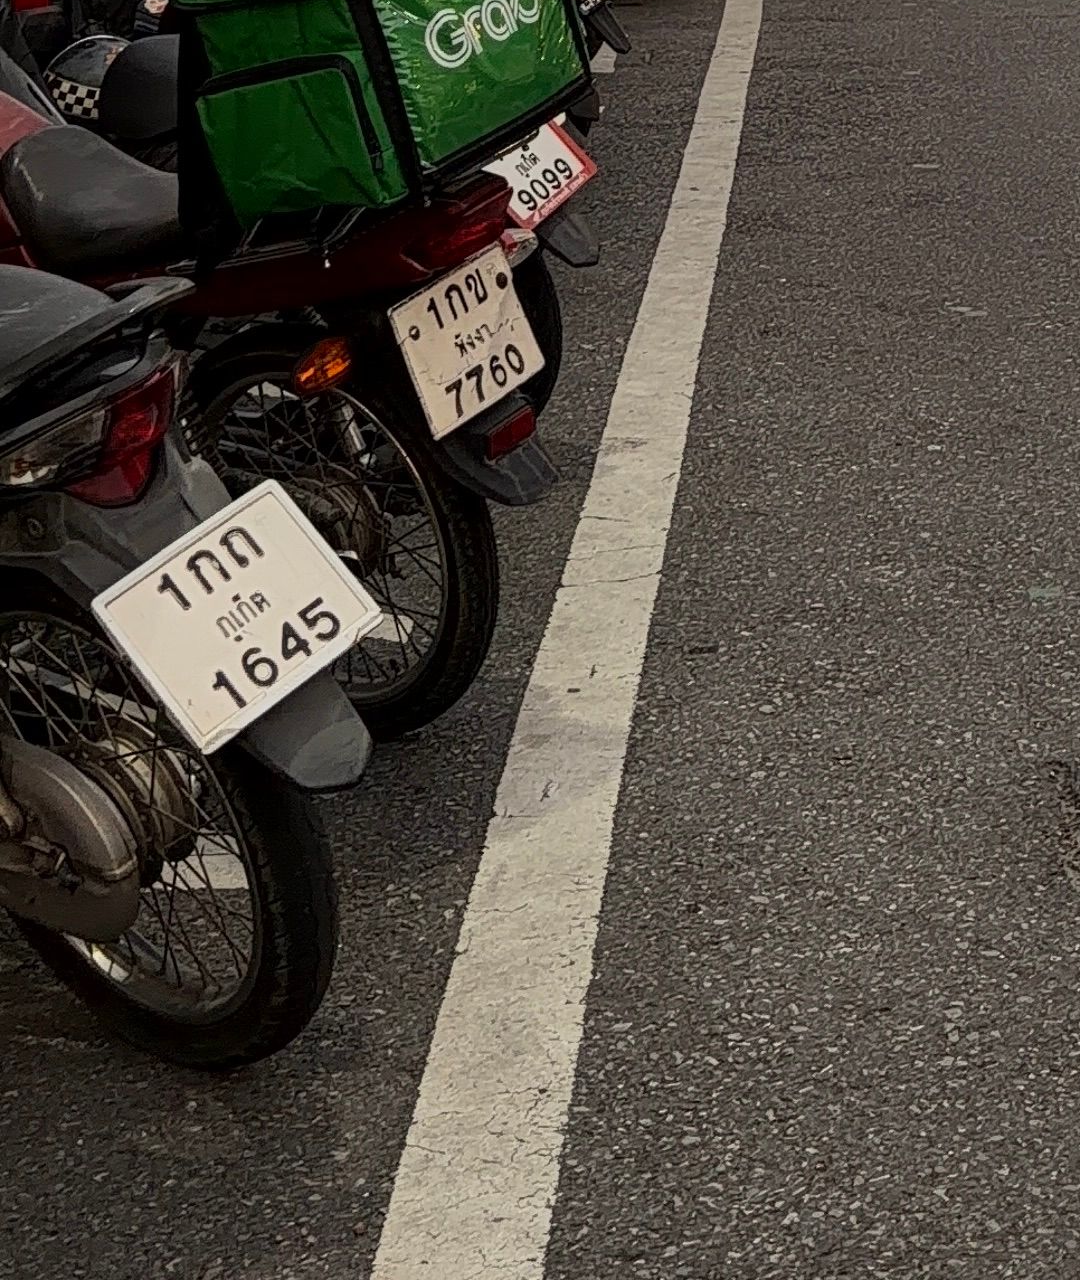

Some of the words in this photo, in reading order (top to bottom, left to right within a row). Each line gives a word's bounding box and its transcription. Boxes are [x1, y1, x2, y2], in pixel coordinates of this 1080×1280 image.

[517, 158, 573, 211] 9099
[427, 268, 489, 330] 1กข
[445, 343, 525, 419] 7760
[157, 526, 265, 611] 1กถ
[216, 591, 272, 642] ภูเก็ต
[212, 597, 341, 709] 1645
